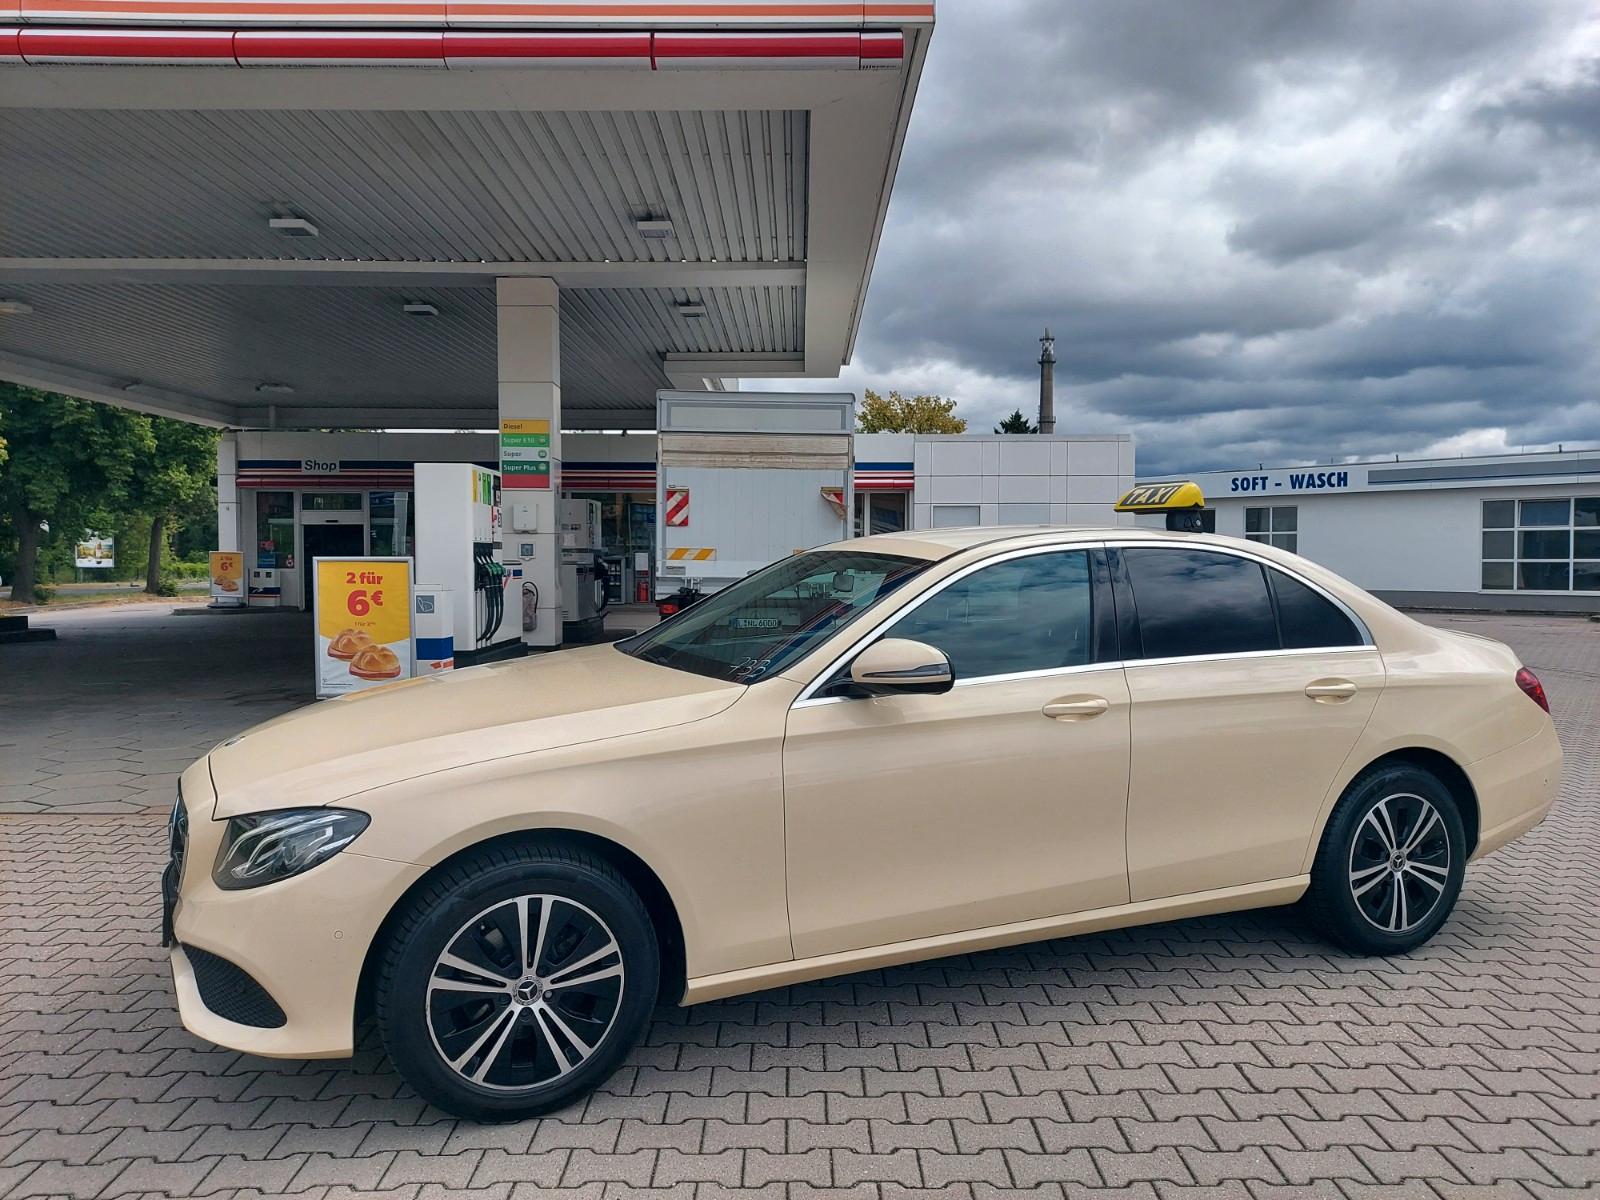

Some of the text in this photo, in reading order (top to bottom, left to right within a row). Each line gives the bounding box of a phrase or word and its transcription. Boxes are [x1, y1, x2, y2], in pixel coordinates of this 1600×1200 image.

[503, 450, 522, 458] Super
[304, 460, 337, 472] Shop
[1231, 476, 1268, 491] SOFT
[1290, 472, 1348, 489] WASCH
[1125, 487, 1178, 504] TAXI
[346, 571, 383, 584] 2 für
[347, 590, 383, 616] 6€
